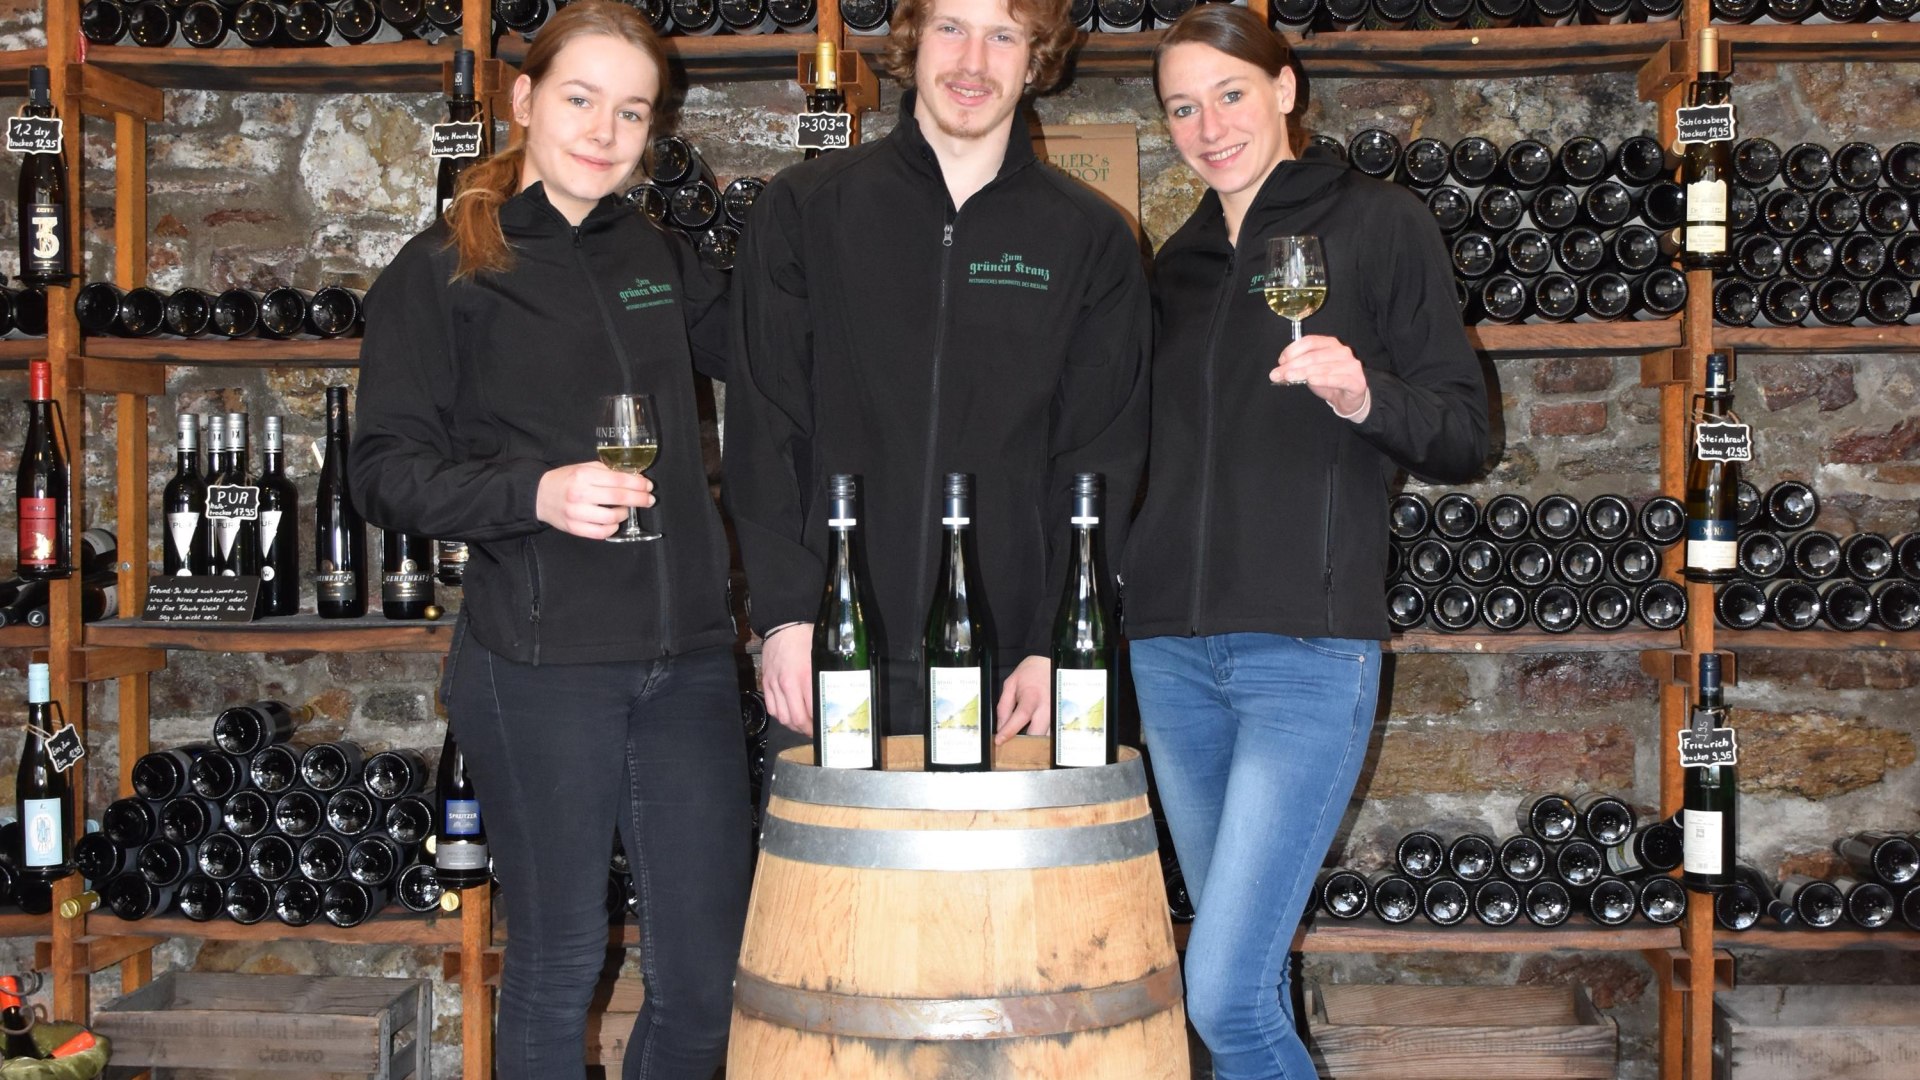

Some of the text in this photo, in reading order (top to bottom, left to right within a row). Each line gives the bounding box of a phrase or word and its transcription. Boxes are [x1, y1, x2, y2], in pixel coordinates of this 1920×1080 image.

[1679, 116, 1729, 127] Schlossberg
[13, 123, 51, 139] 1,2 dry
[1681, 130, 1707, 139] trocken
[10, 138, 58, 150] trocken 12,95
[822, 133, 846, 145] 29,90
[432, 146, 454, 154] trocken
[1000, 253, 1022, 263] Zum
[969, 261, 1050, 281] grünen Kranz
[217, 490, 249, 505] PUR
[232, 507, 256, 517] 17,95
[1711, 750, 1732, 762] 9,95
